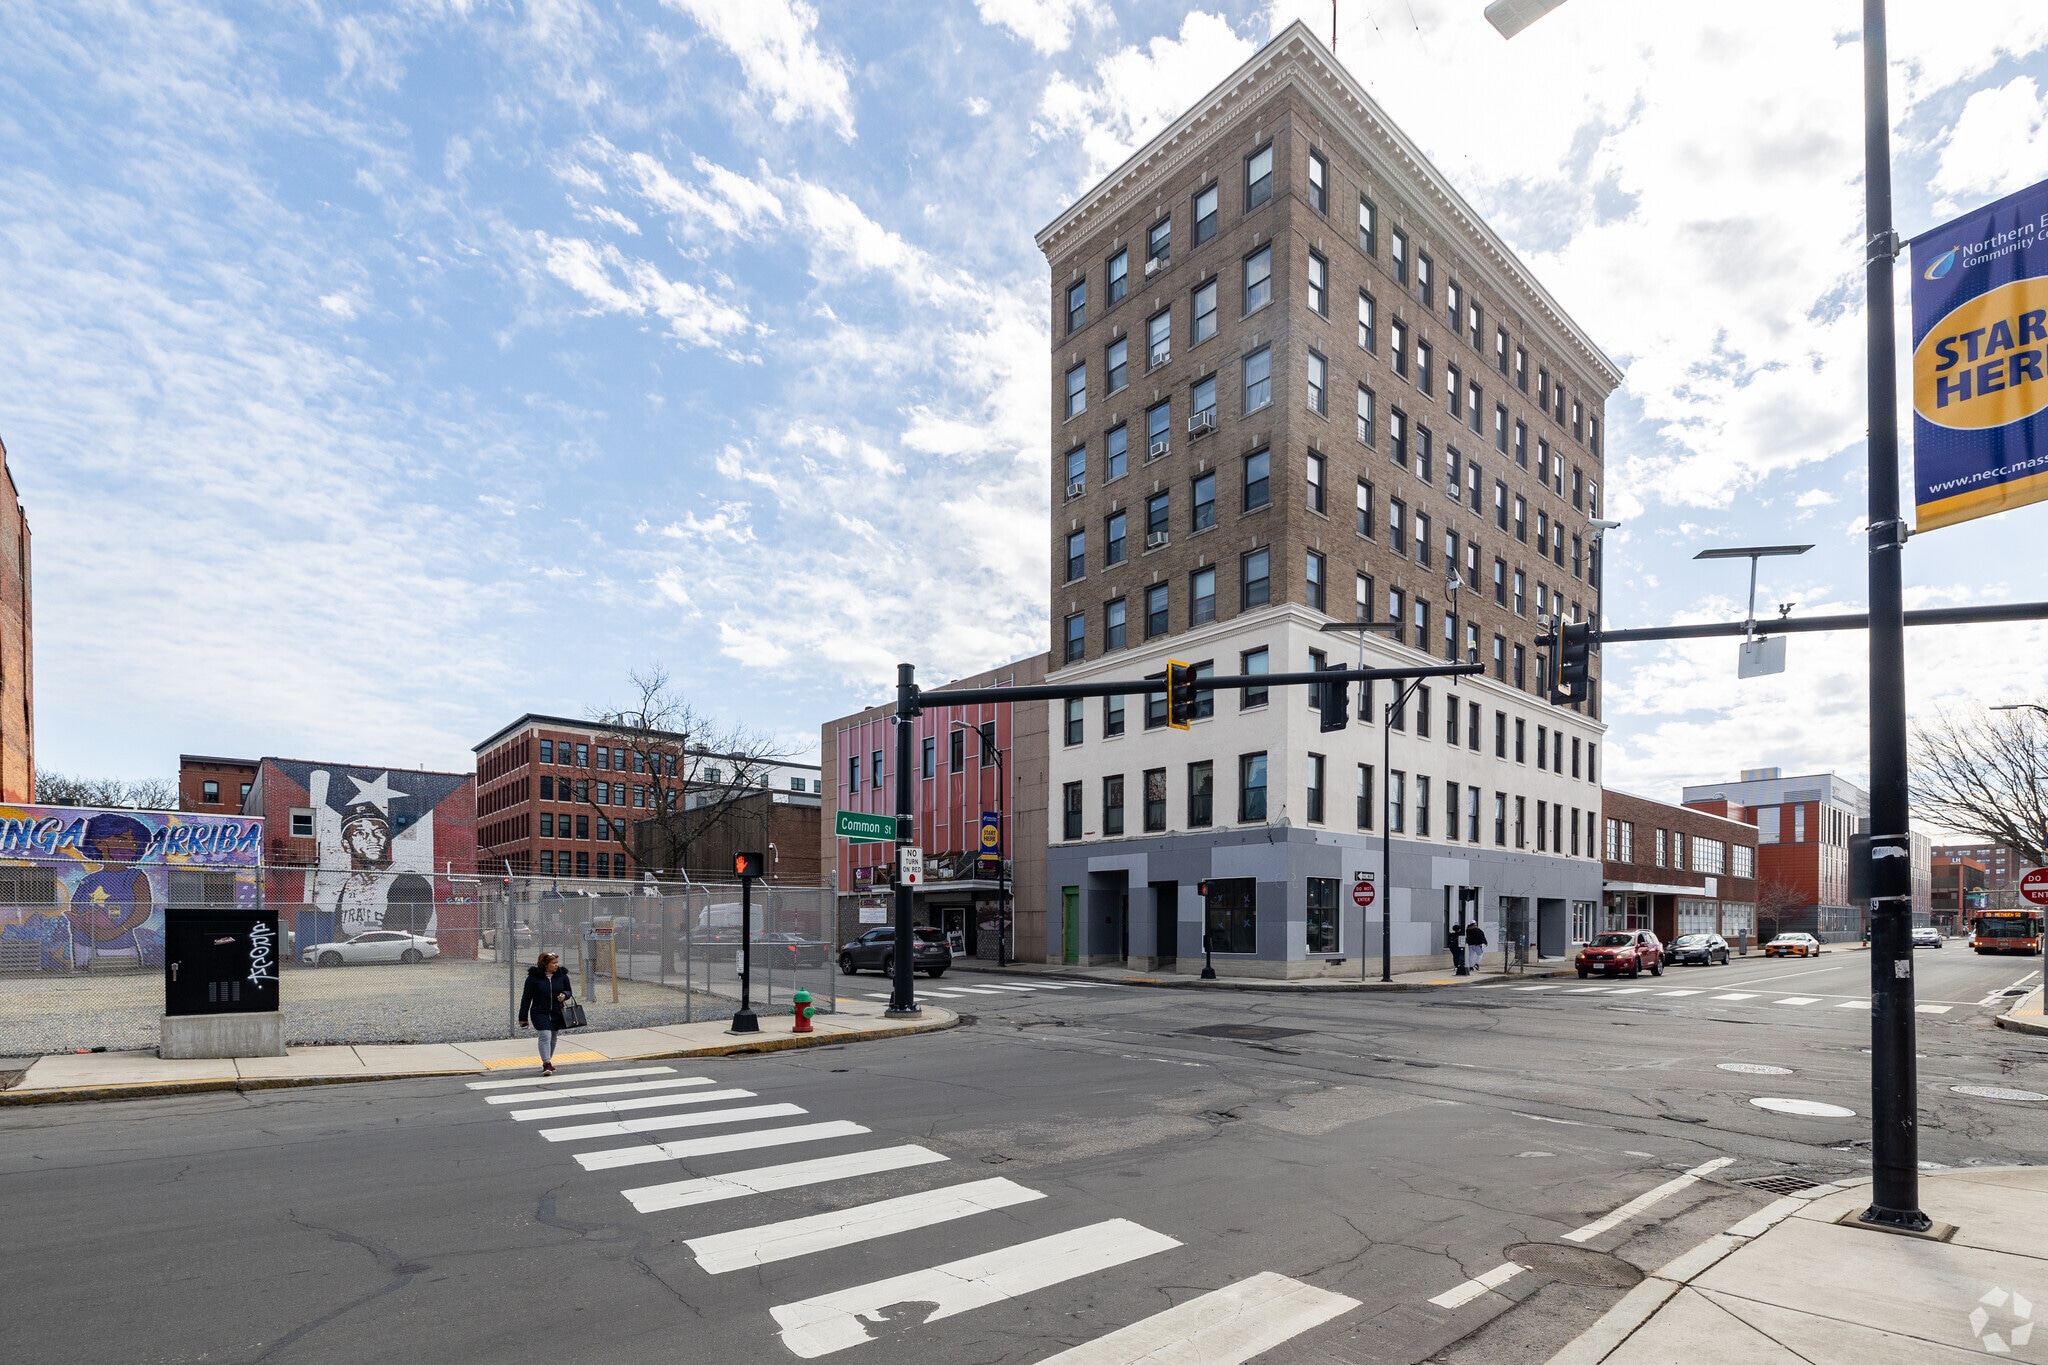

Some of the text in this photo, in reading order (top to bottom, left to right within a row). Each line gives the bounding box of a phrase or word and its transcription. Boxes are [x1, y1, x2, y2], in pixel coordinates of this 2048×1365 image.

[1962, 237, 2034, 268] Community
[1963, 223, 2034, 257] Northern
[1936, 344, 2048, 408] HER
[146, 822, 263, 857] ARRIBA
[841, 817, 892, 834] Common St
